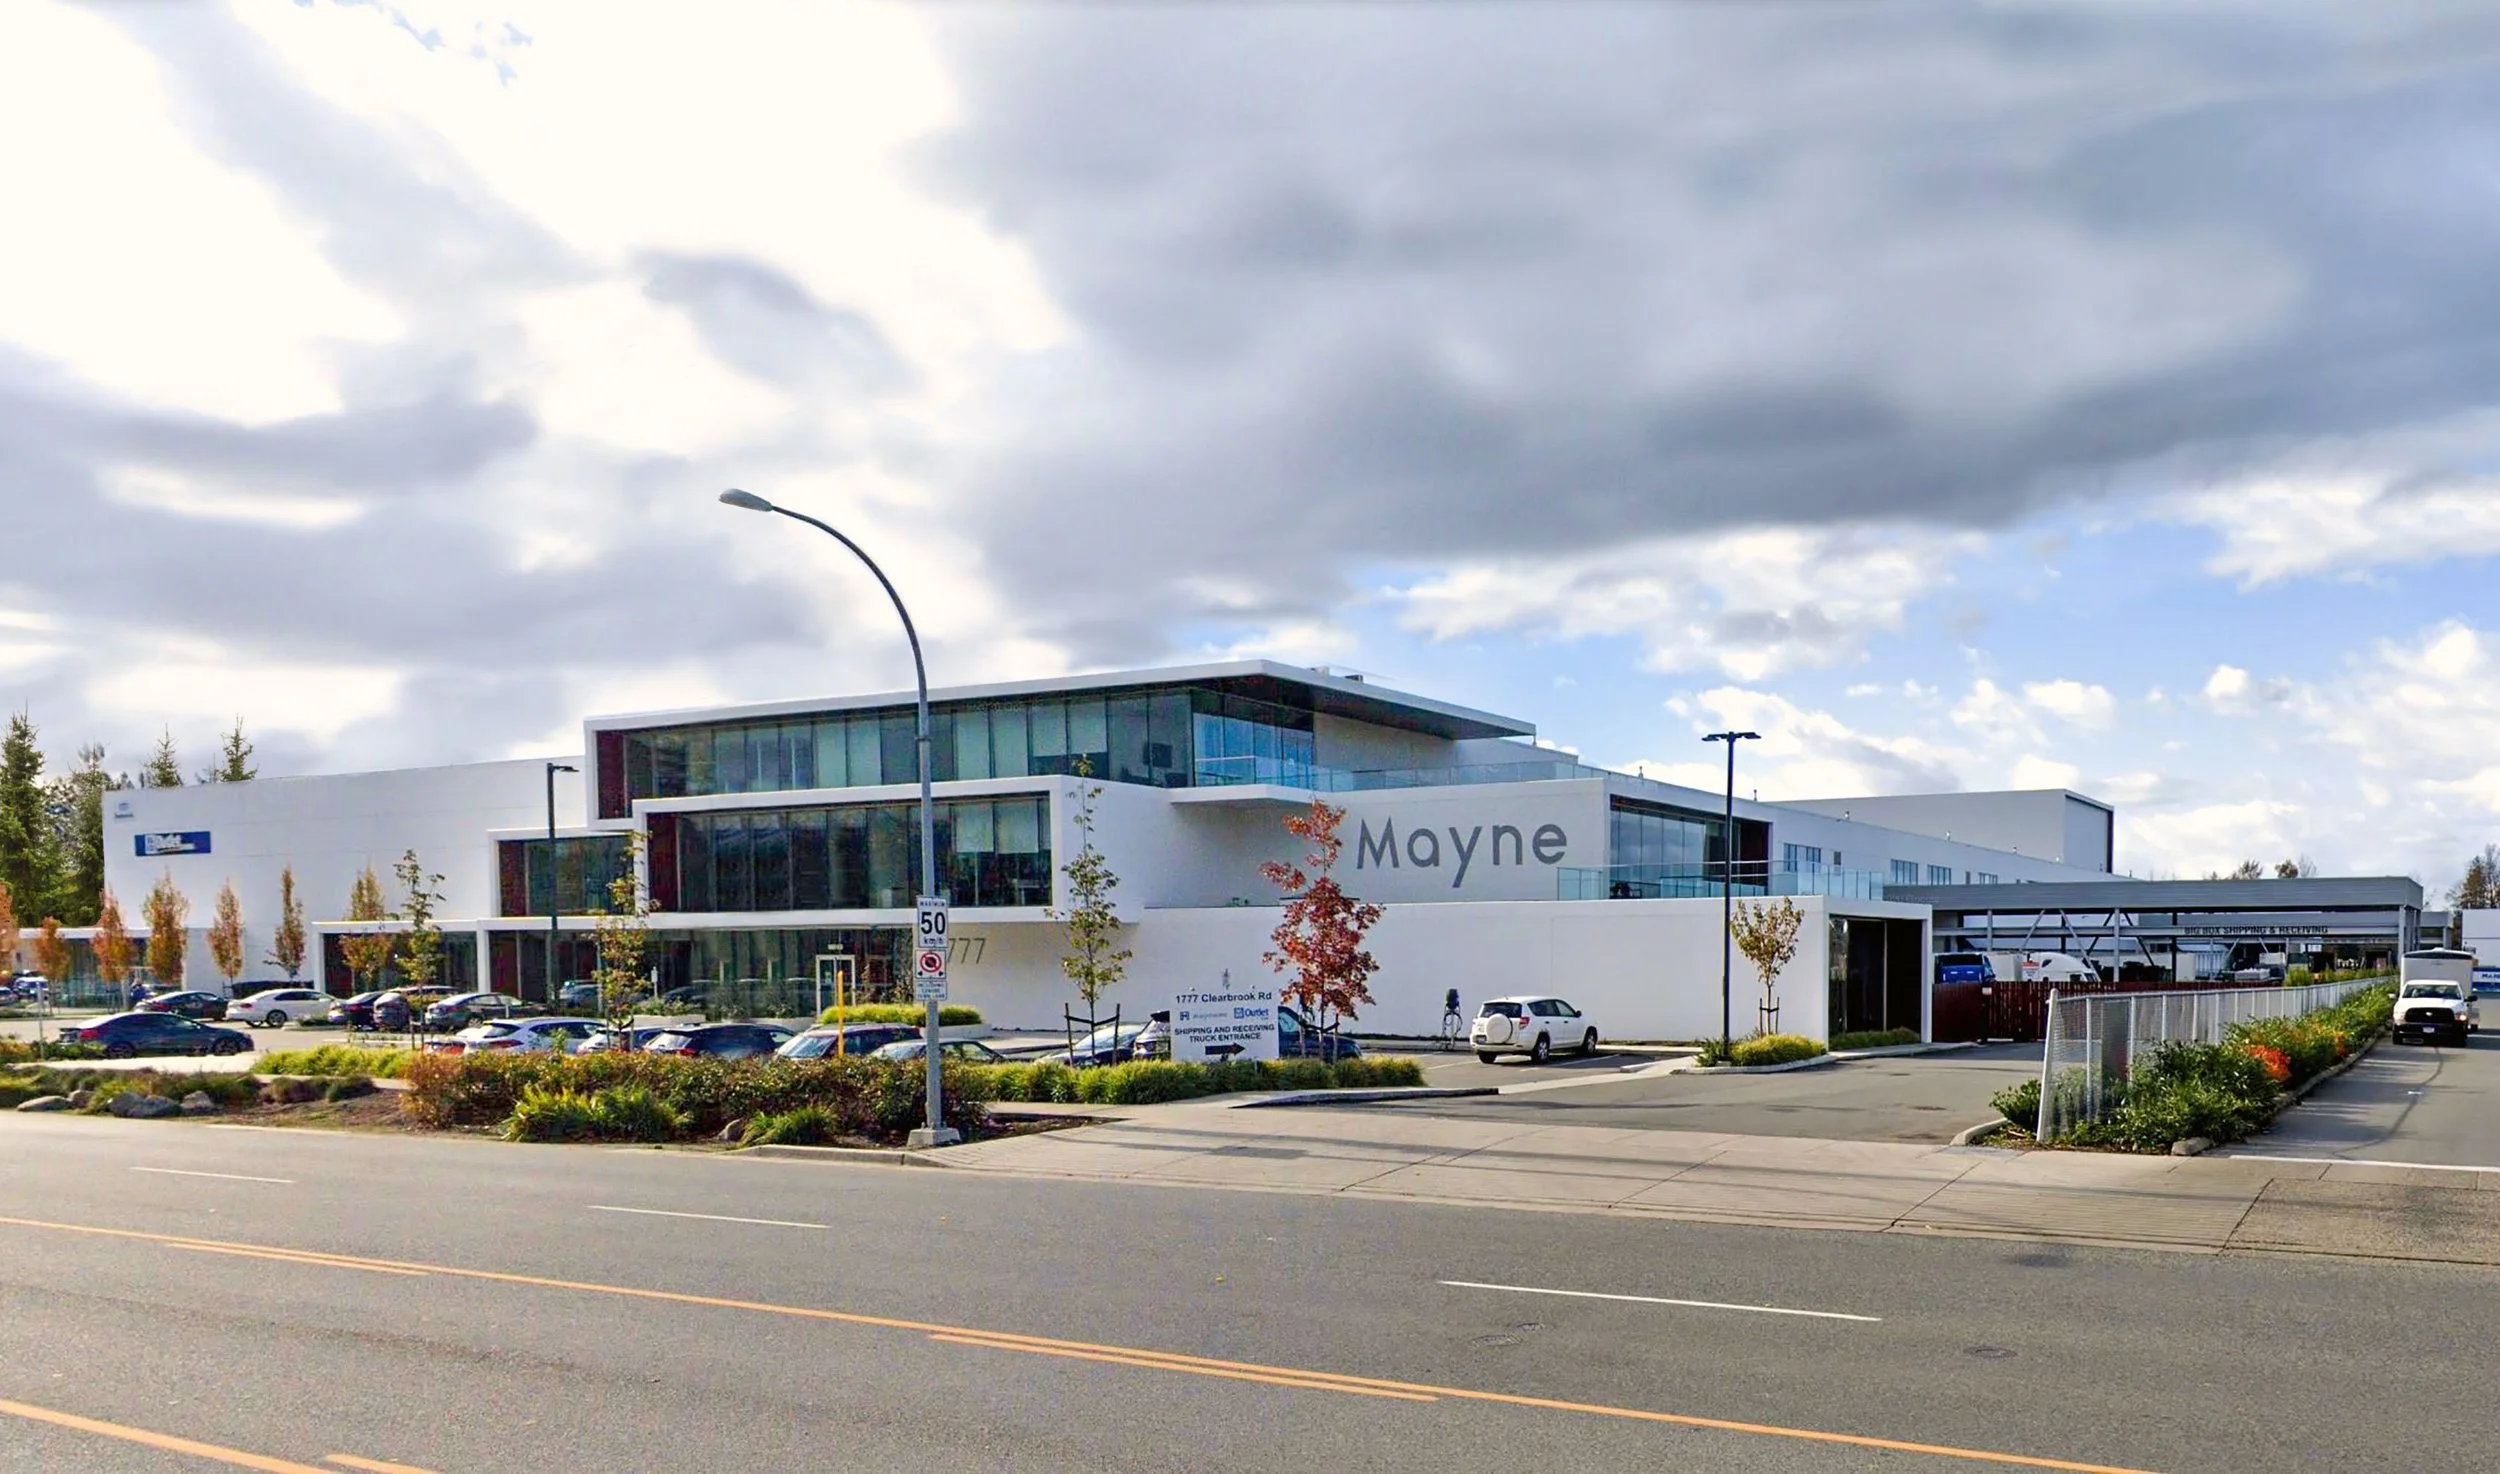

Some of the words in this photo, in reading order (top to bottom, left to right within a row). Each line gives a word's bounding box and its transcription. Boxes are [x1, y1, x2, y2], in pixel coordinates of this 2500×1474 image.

[1356, 816, 1567, 888] Mayne
[921, 911, 946, 935] 50
[2223, 926, 2266, 935] SHIPPING
[2279, 925, 2328, 934] RECEIVING
[923, 937, 944, 945] km/h
[1176, 994, 1199, 1004] 1777
[1201, 992, 1256, 1002] Clearbrook
[1258, 991, 1272, 1000] Rd
[1244, 1008, 1269, 1018] Outlet
[1174, 1026, 1212, 1036] SHIPPING
[1213, 1025, 1231, 1034] AND
[1232, 1023, 1275, 1033] RECEIVING
[1189, 1034, 1217, 1043] TRUCK
[1218, 1032, 1261, 1042] ENTRANCE
